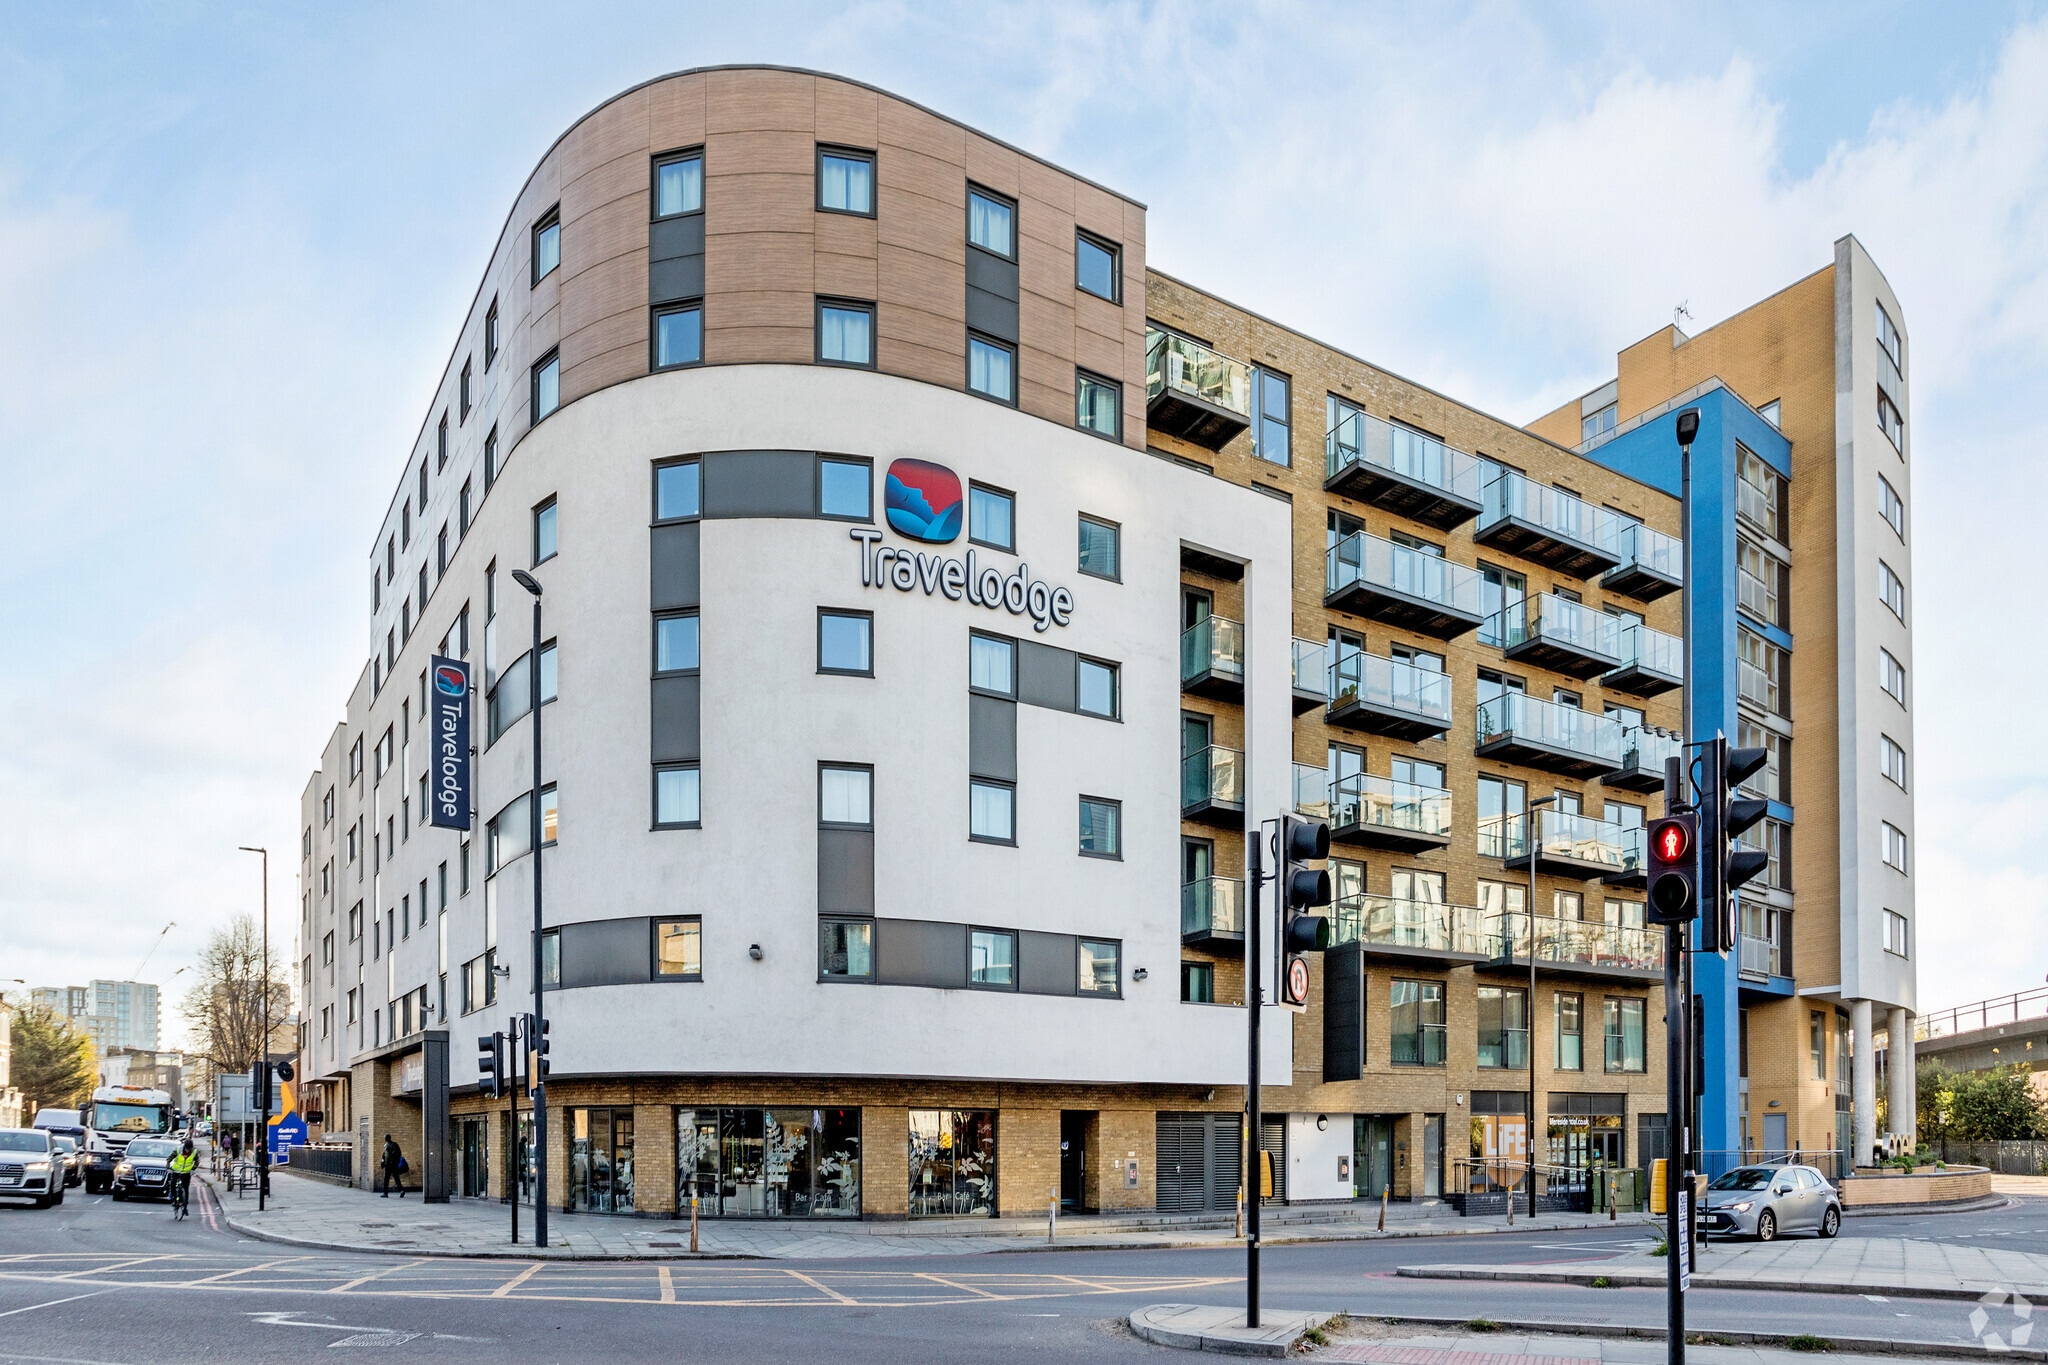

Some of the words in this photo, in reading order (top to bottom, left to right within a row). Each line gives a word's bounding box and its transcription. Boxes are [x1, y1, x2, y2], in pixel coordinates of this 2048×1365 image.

[850, 528, 1074, 633] Travelodge
[438, 702, 462, 817] Travelodge
[795, 1192, 807, 1202] Bar
[937, 1192, 948, 1201] Bar
[955, 1191, 970, 1200] Café
